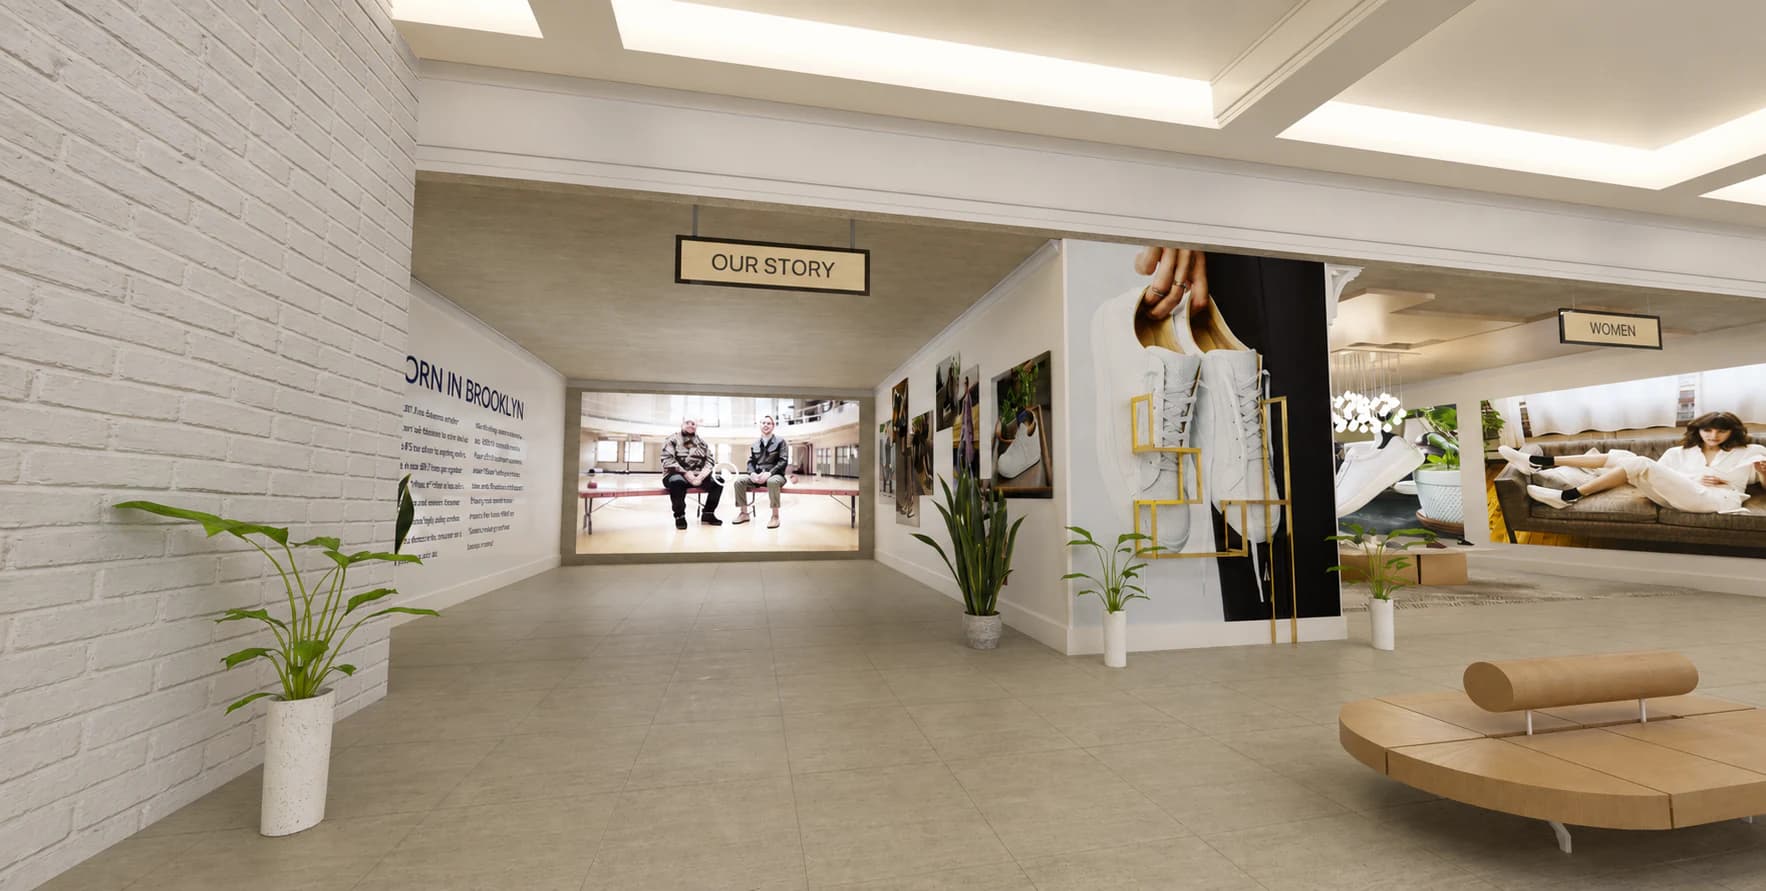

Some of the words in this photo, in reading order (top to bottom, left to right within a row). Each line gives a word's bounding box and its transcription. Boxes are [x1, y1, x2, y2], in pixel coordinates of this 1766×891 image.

[711, 253, 758, 274] OUR
[764, 257, 835, 279] STORY
[1589, 321, 1637, 337] WOMEN
[404, 355, 443, 393] ORN
[447, 371, 462, 399] IN
[465, 378, 525, 420] BROOKLYN
